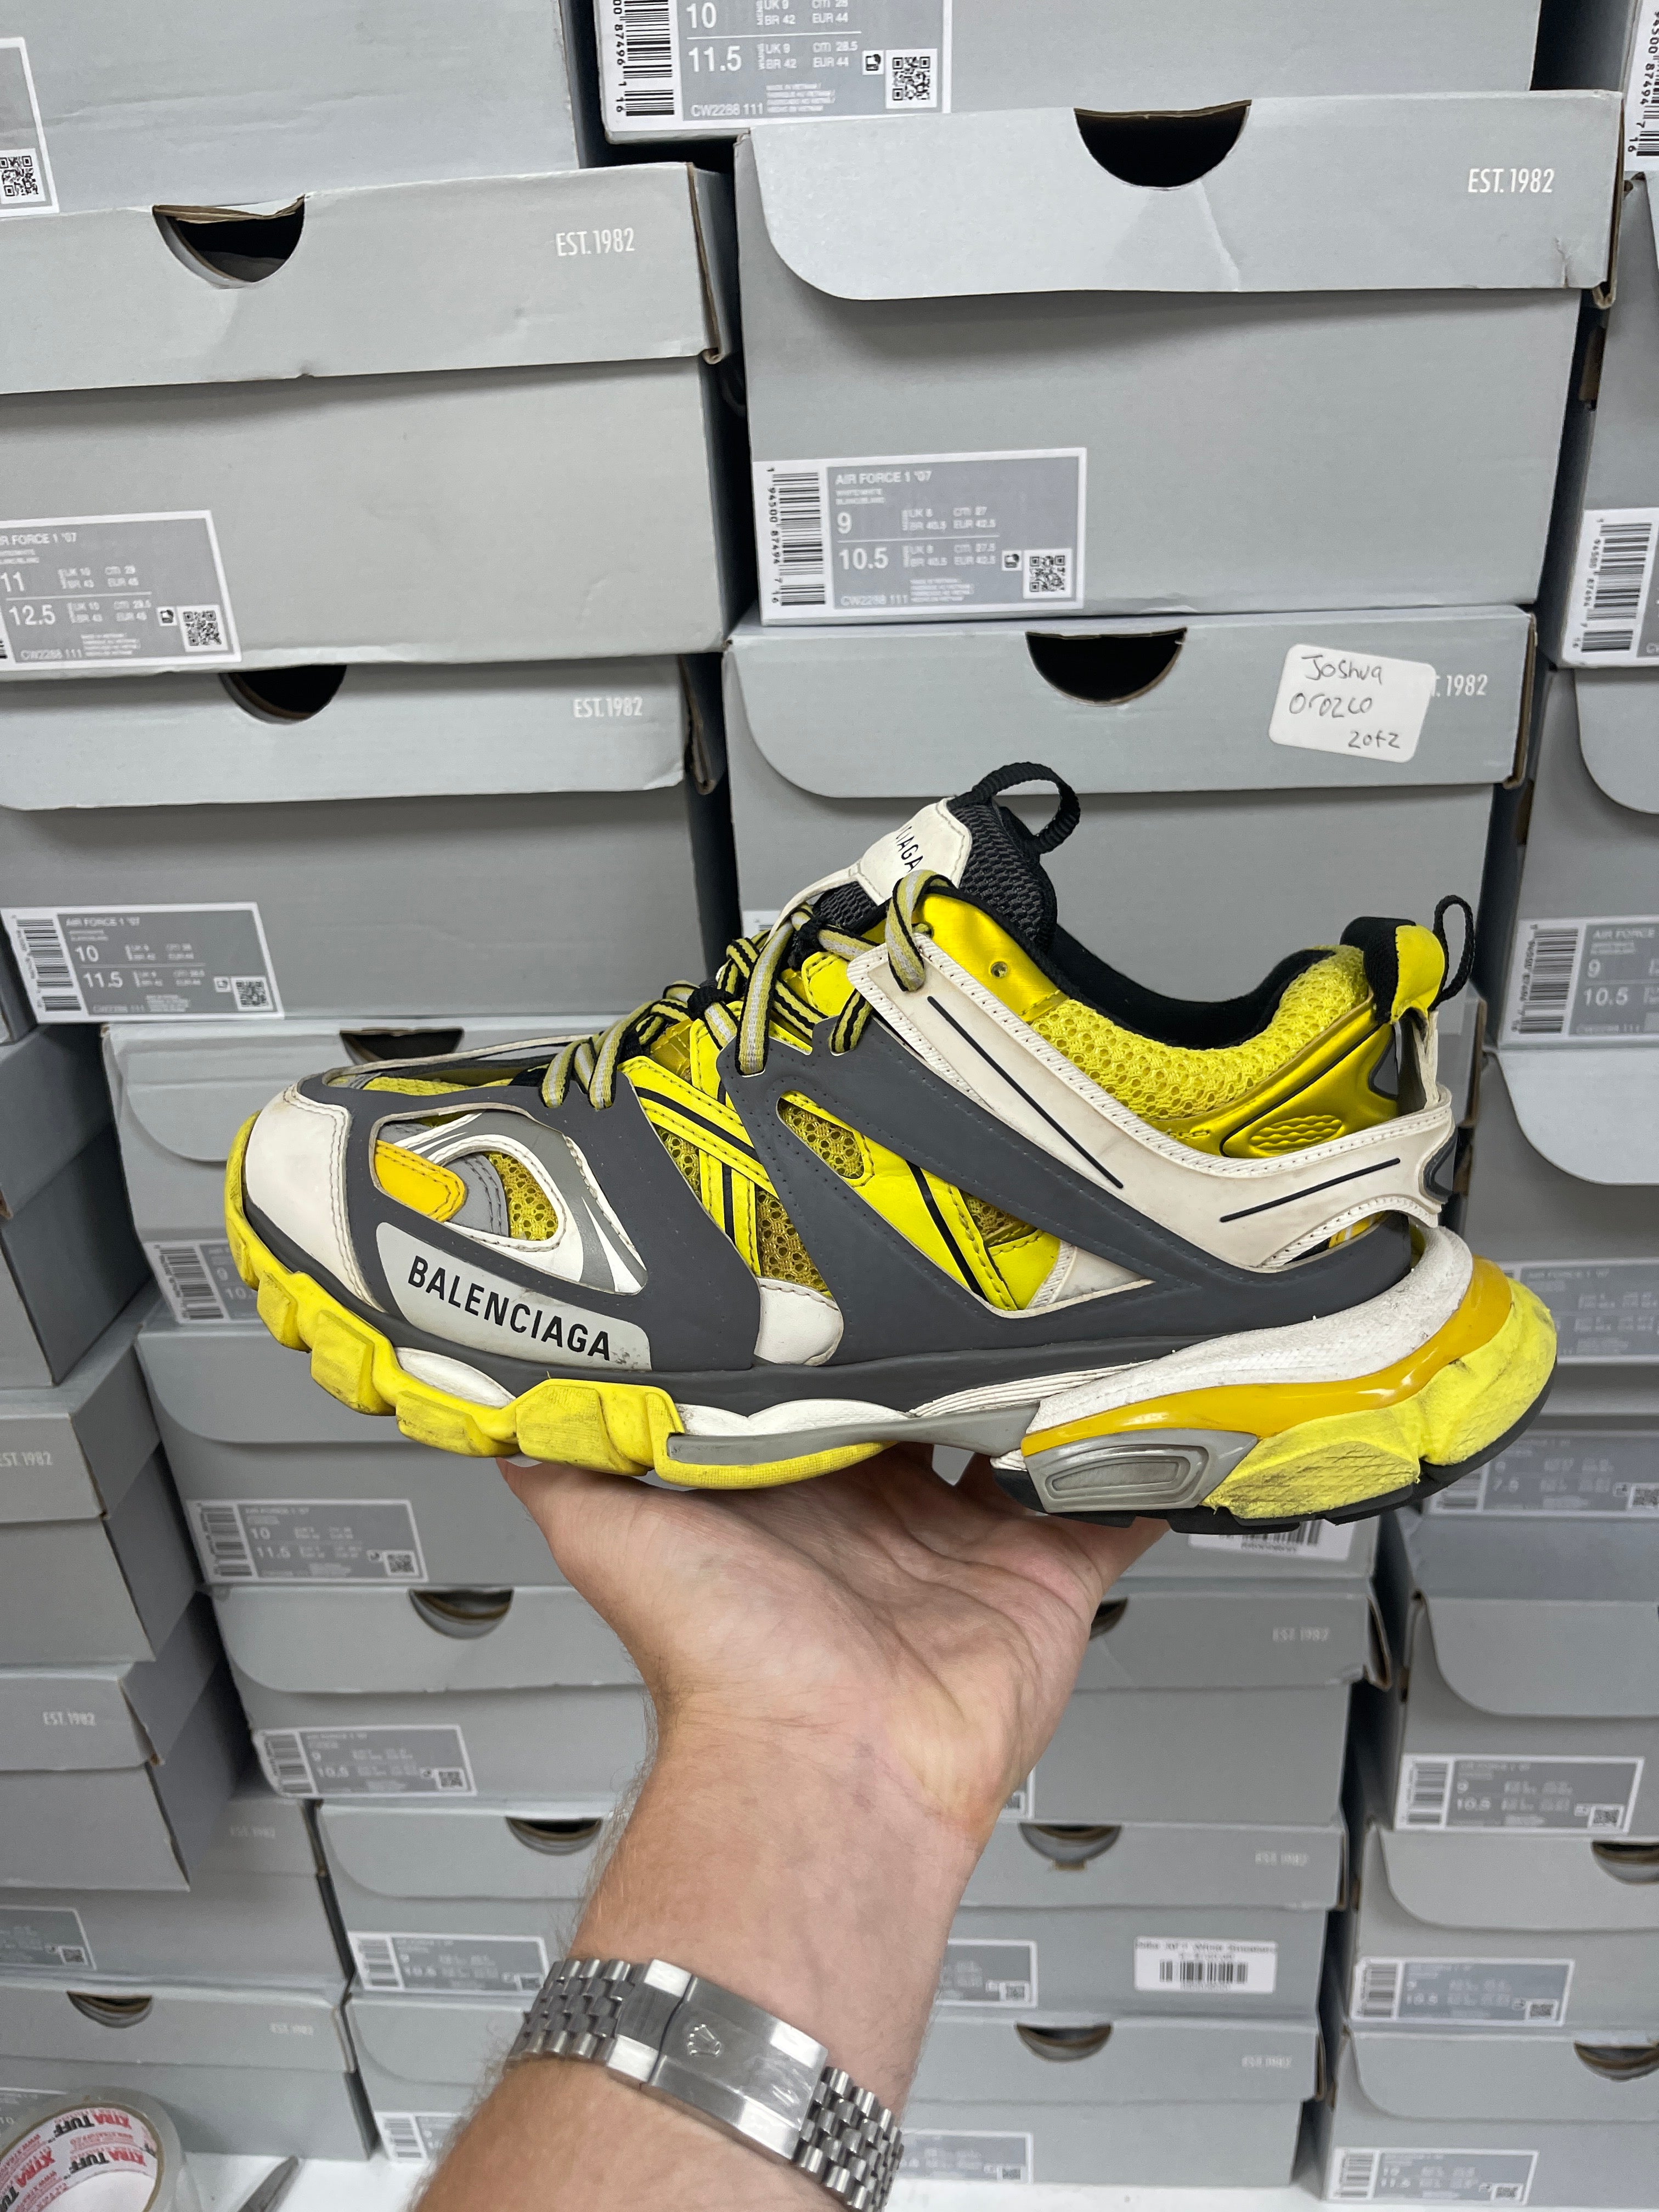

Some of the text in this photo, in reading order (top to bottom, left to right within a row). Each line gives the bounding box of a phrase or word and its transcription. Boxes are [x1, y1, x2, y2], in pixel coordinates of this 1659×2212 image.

[686, 2, 716, 28] 10
[783, 14, 796, 25] 42
[812, 12, 849, 24] EUR 44
[614, 24, 625, 65] 87496
[688, 46, 742, 72] 11.5
[783, 58, 797, 69] 42
[813, 57, 849, 67] EUR 44
[1639, 63, 1655, 105] 87494
[743, 103, 763, 115] 111
[1628, 136, 1638, 153] 16
[1468, 168, 1555, 193] EST. 1982
[556, 228, 635, 256] EST. 1982
[835, 473, 856, 485] AIR
[859, 472, 901, 484] FORCE
[837, 511, 853, 534] 9
[12, 533, 50, 545] FORCE
[839, 548, 889, 569] 10.5
[9, 604, 55, 626] 12.5
[1447, 674, 1488, 696] 1982
[606, 696, 644, 717] 1982
[75, 944, 99, 962] 10
[83, 971, 123, 988] 11.5
[408, 1255, 610, 1361] BALENCIAGA
[53, 2114, 95, 2138] TUFF
[15, 2149, 55, 2187] XTRA
[69, 2152, 110, 2174] TUFF
